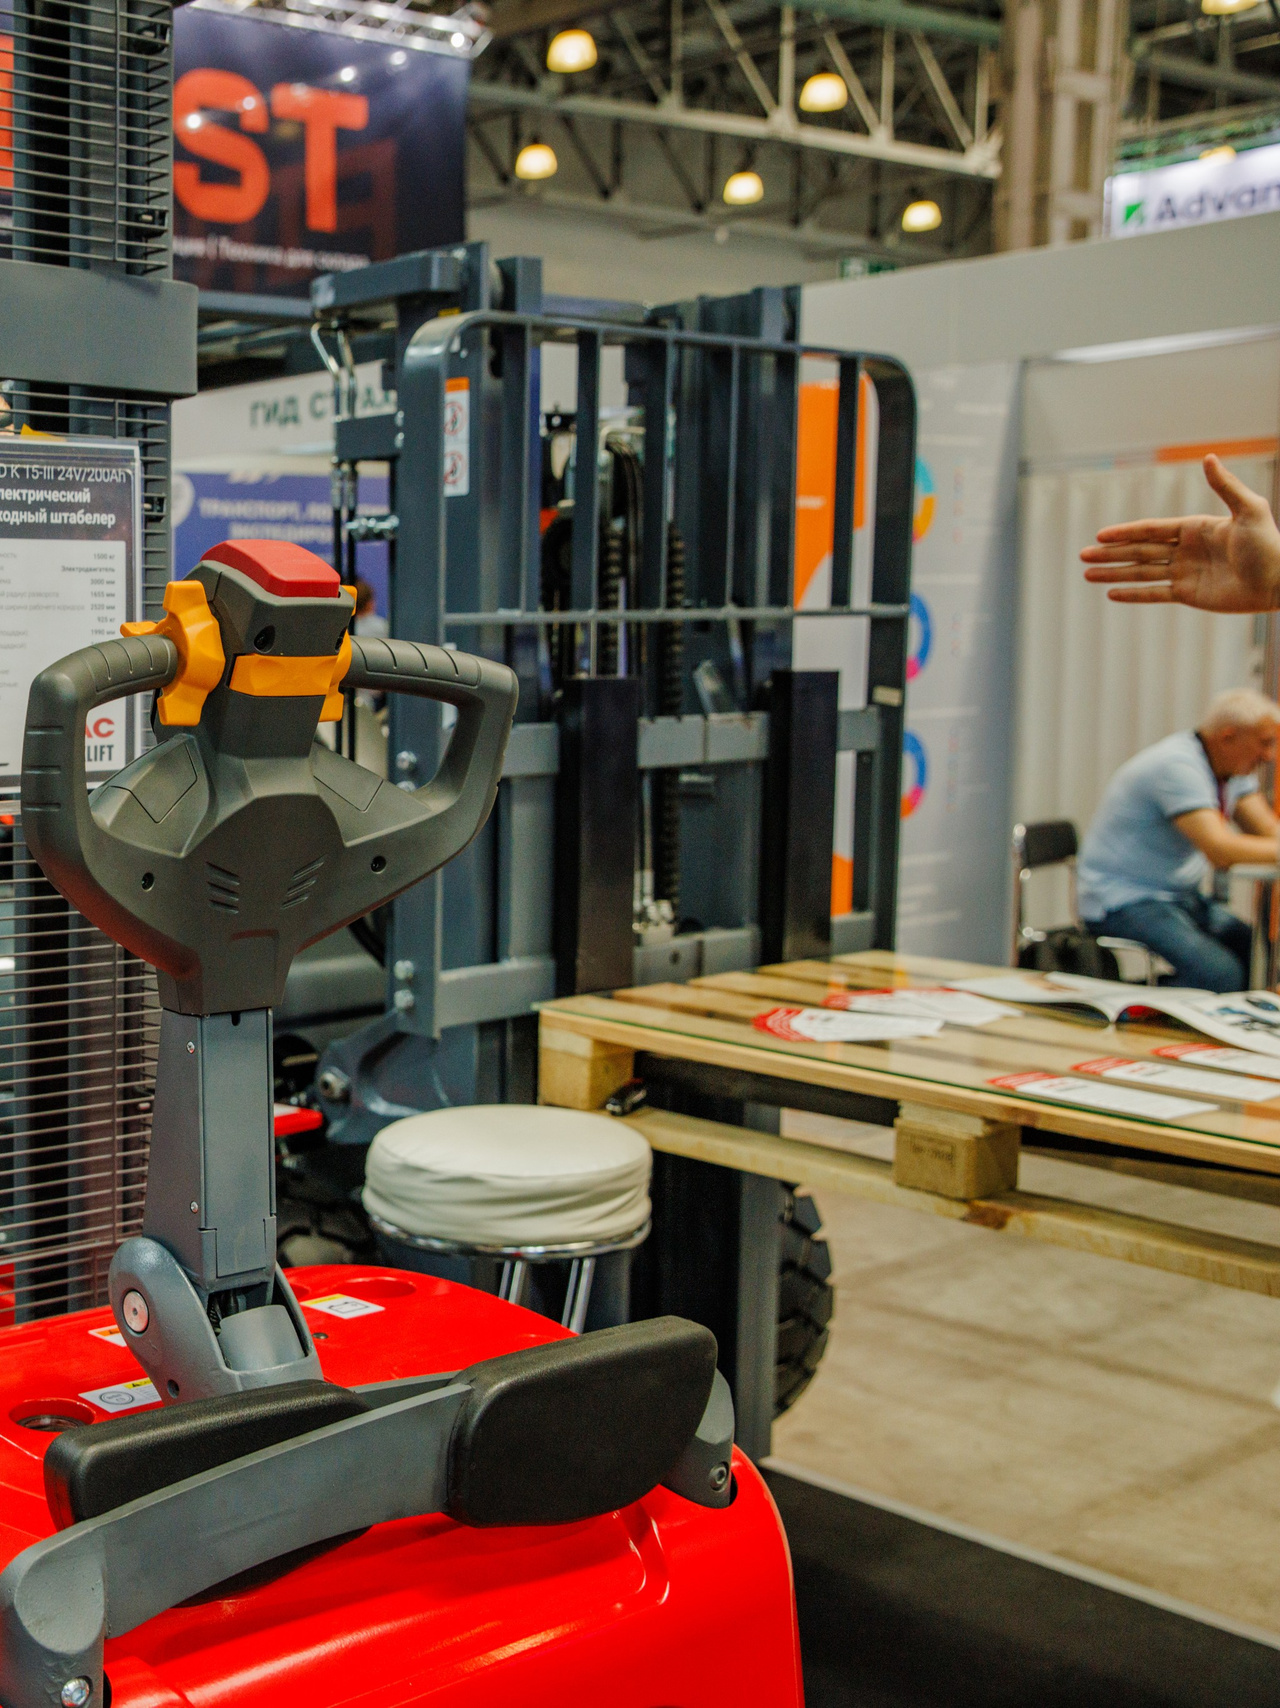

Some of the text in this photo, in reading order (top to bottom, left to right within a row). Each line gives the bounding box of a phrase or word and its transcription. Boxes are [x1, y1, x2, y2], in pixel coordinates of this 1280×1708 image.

[57, 466, 126, 483] 24V/200Ah
[50, 509, 116, 528] штабелер
[87, 744, 114, 762] LIFT
